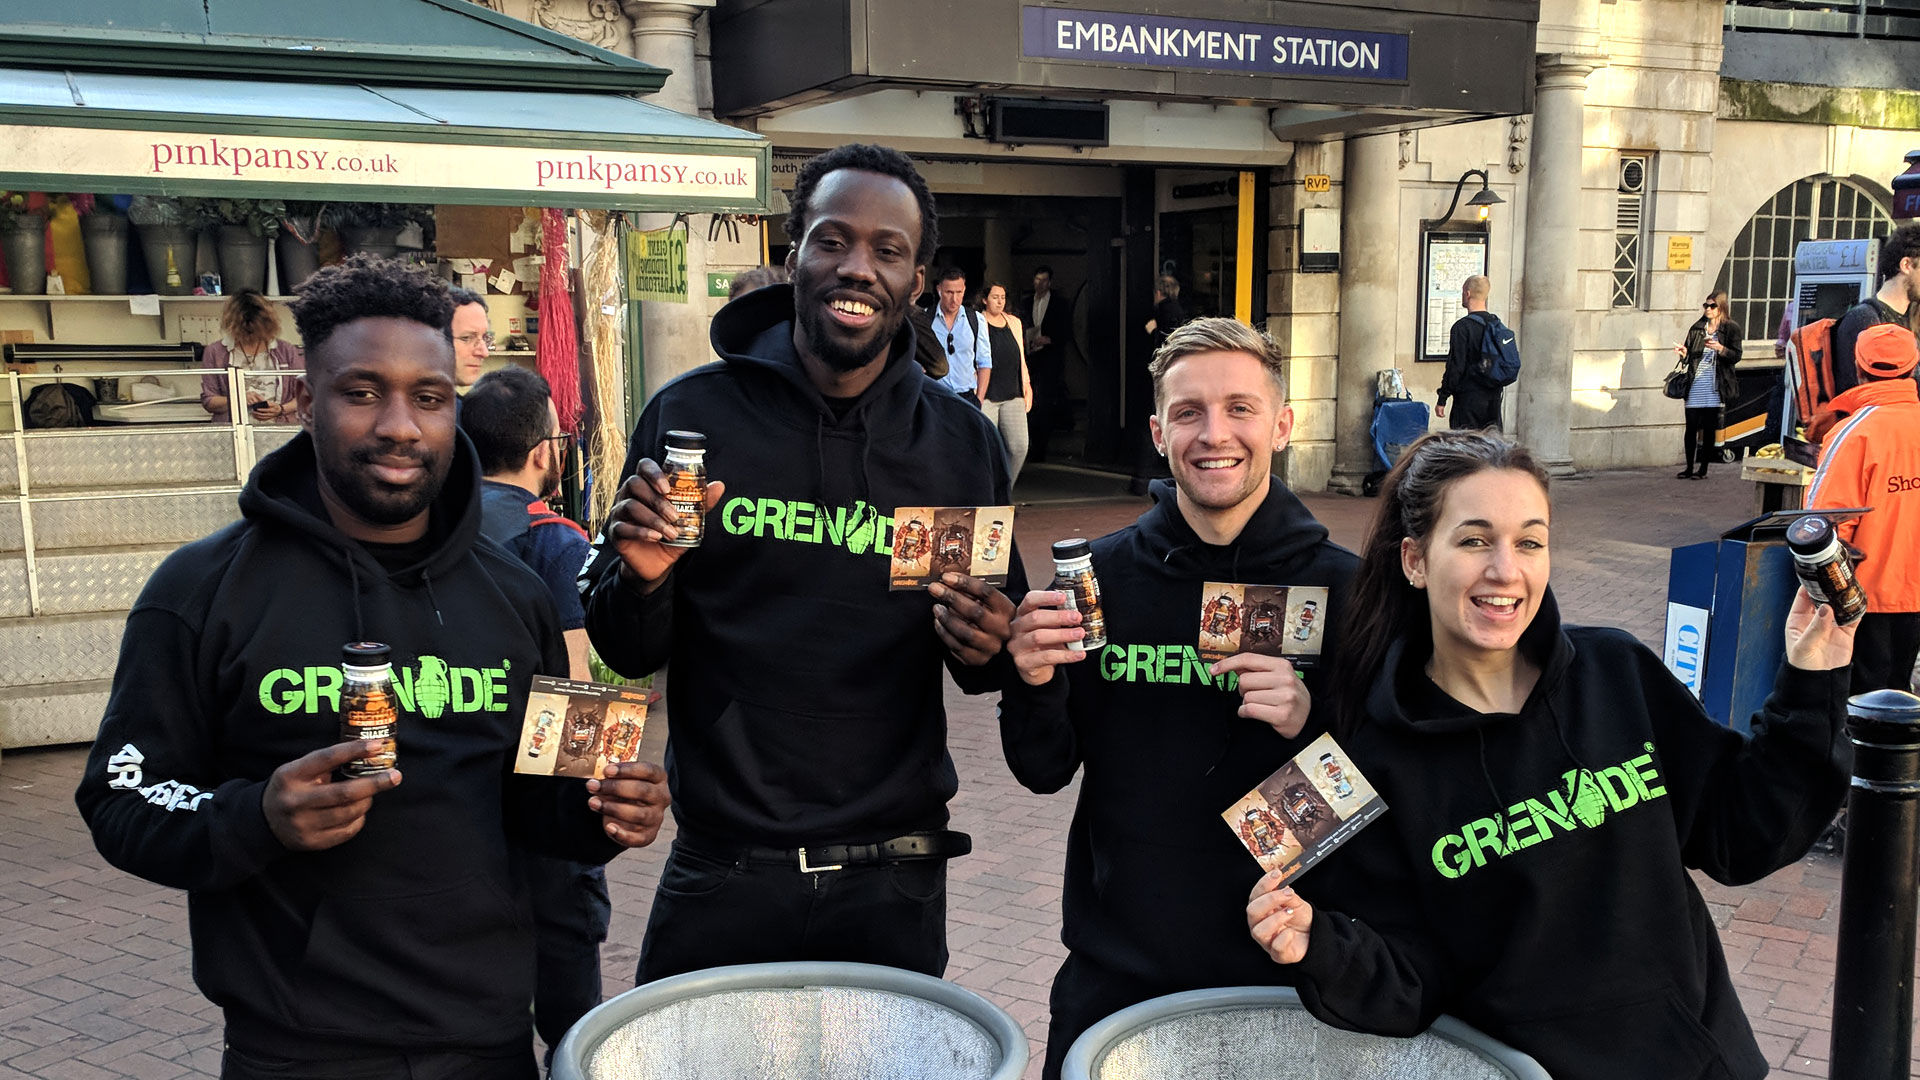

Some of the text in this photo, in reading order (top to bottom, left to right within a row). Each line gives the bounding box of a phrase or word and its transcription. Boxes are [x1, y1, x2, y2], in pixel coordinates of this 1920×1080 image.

[1057, 20, 1380, 70] EMBANKMENT STATION
[771, 162, 798, 173] outh
[1307, 178, 1328, 188] RVP
[1840, 245, 1860, 268] £1
[360, 728, 390, 740] SHAKE
